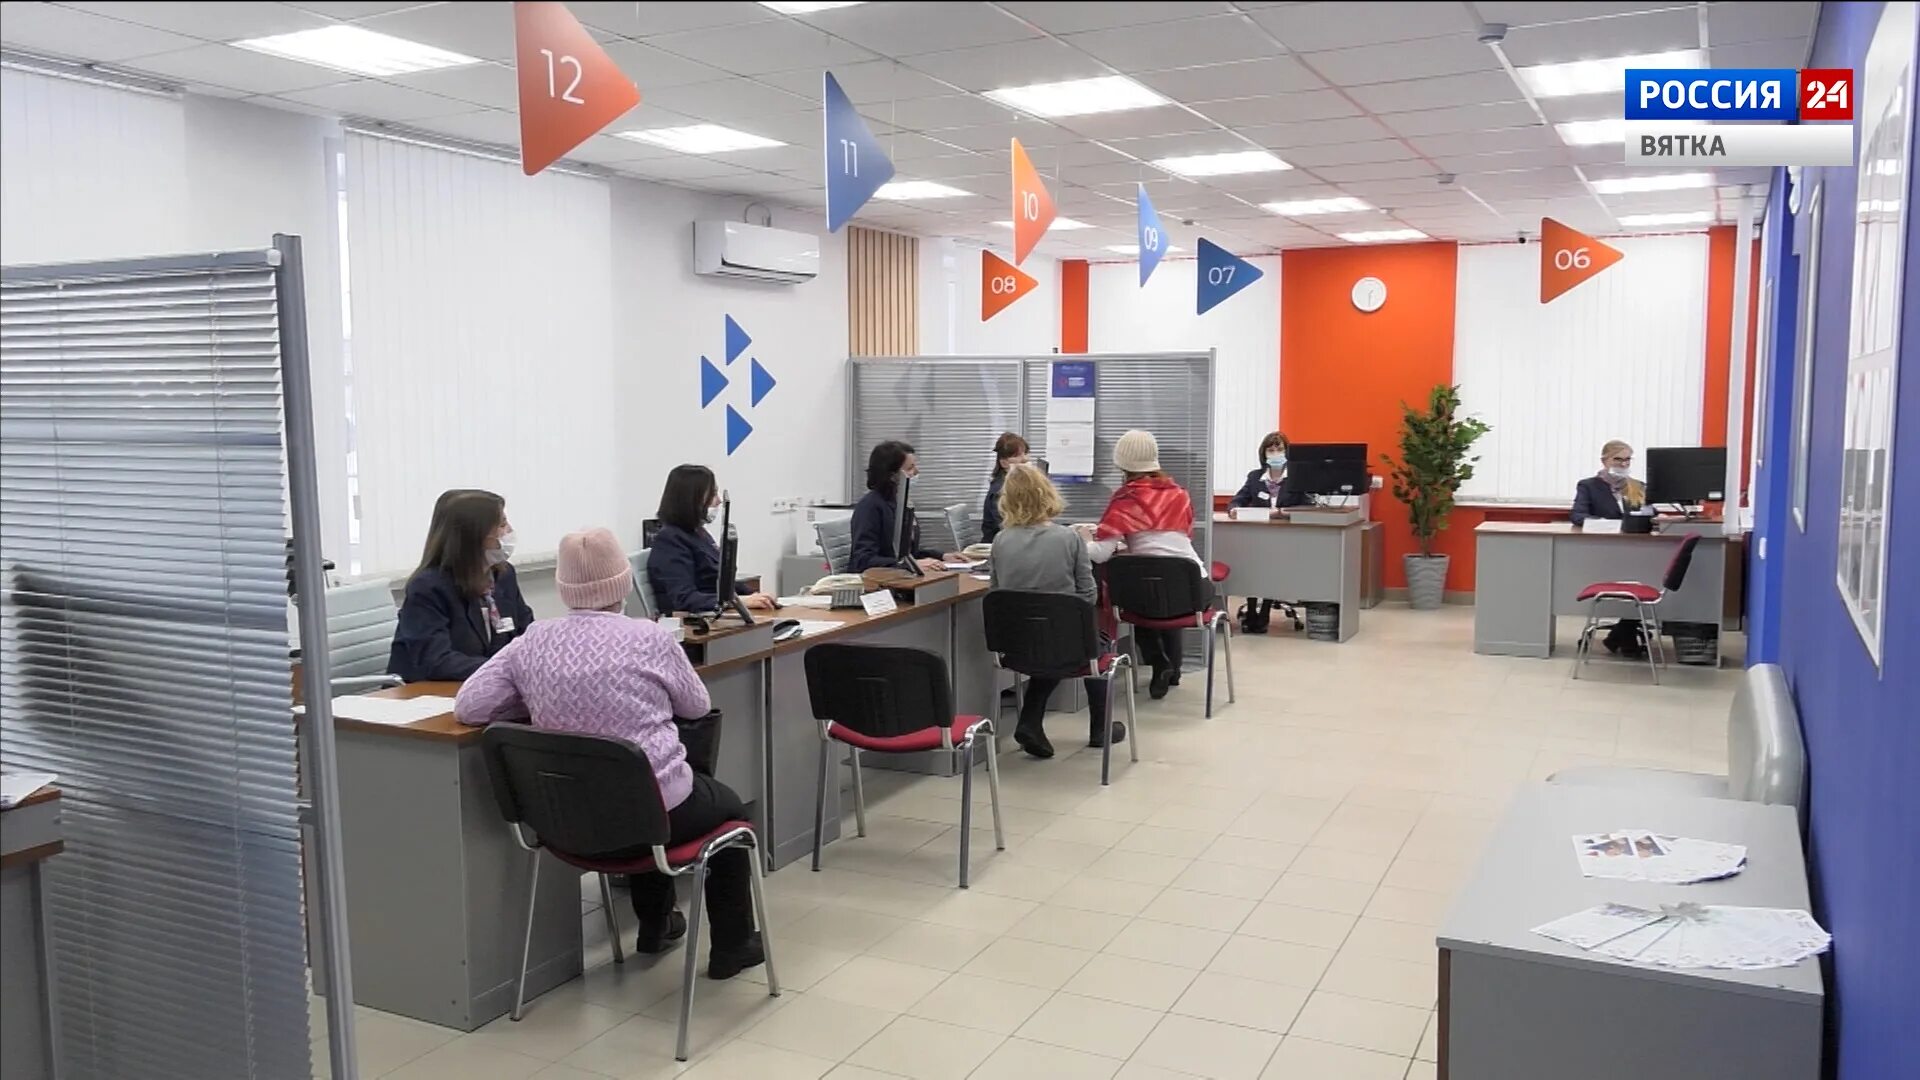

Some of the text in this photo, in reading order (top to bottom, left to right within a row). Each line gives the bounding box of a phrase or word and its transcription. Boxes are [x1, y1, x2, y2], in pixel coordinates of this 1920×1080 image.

[540, 48, 585, 105] 12
[840, 139, 858, 177] 11
[1022, 191, 1040, 222] 10
[1144, 227, 1158, 251] 09
[1554, 247, 1591, 271] 06
[991, 275, 1017, 295] 08
[1208, 266, 1235, 286] 07
